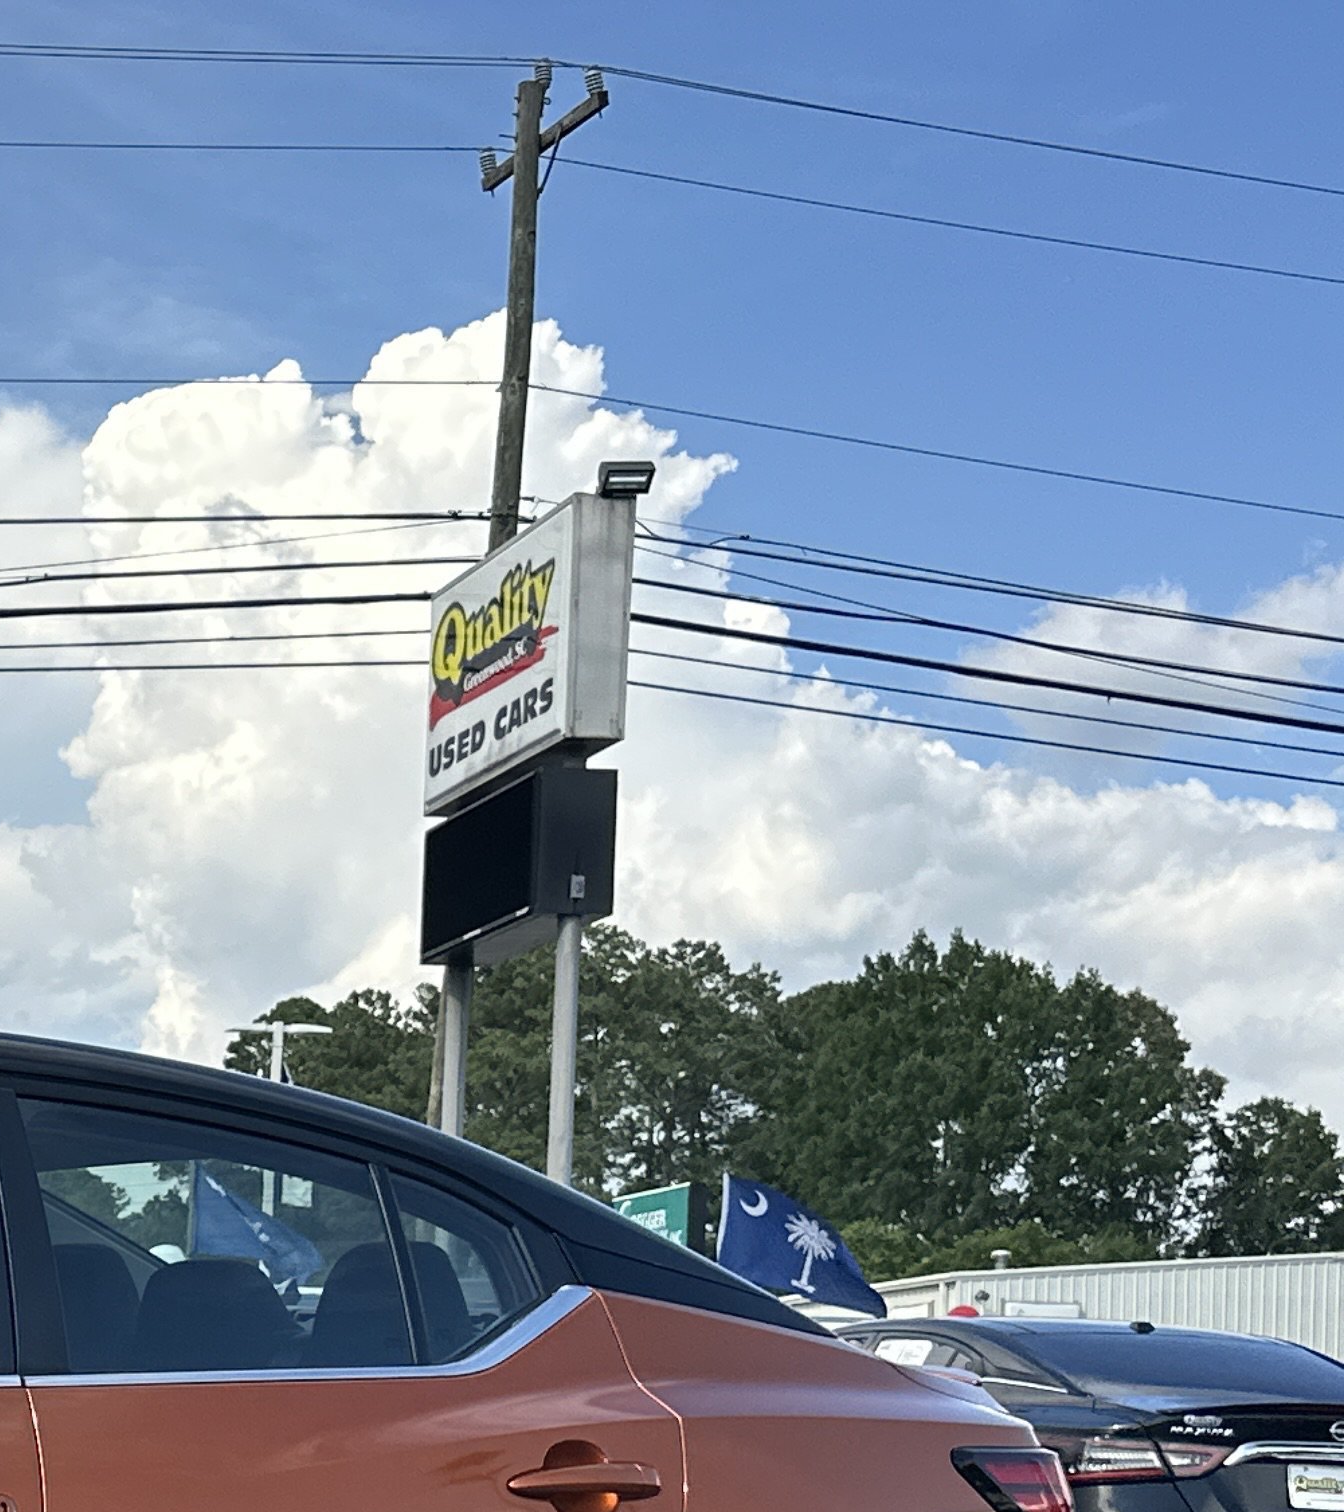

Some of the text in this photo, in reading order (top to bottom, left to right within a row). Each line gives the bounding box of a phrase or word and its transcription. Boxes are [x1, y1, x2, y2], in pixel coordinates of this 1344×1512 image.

[432, 557, 555, 690] Quality
[429, 677, 553, 777] USED CARS
